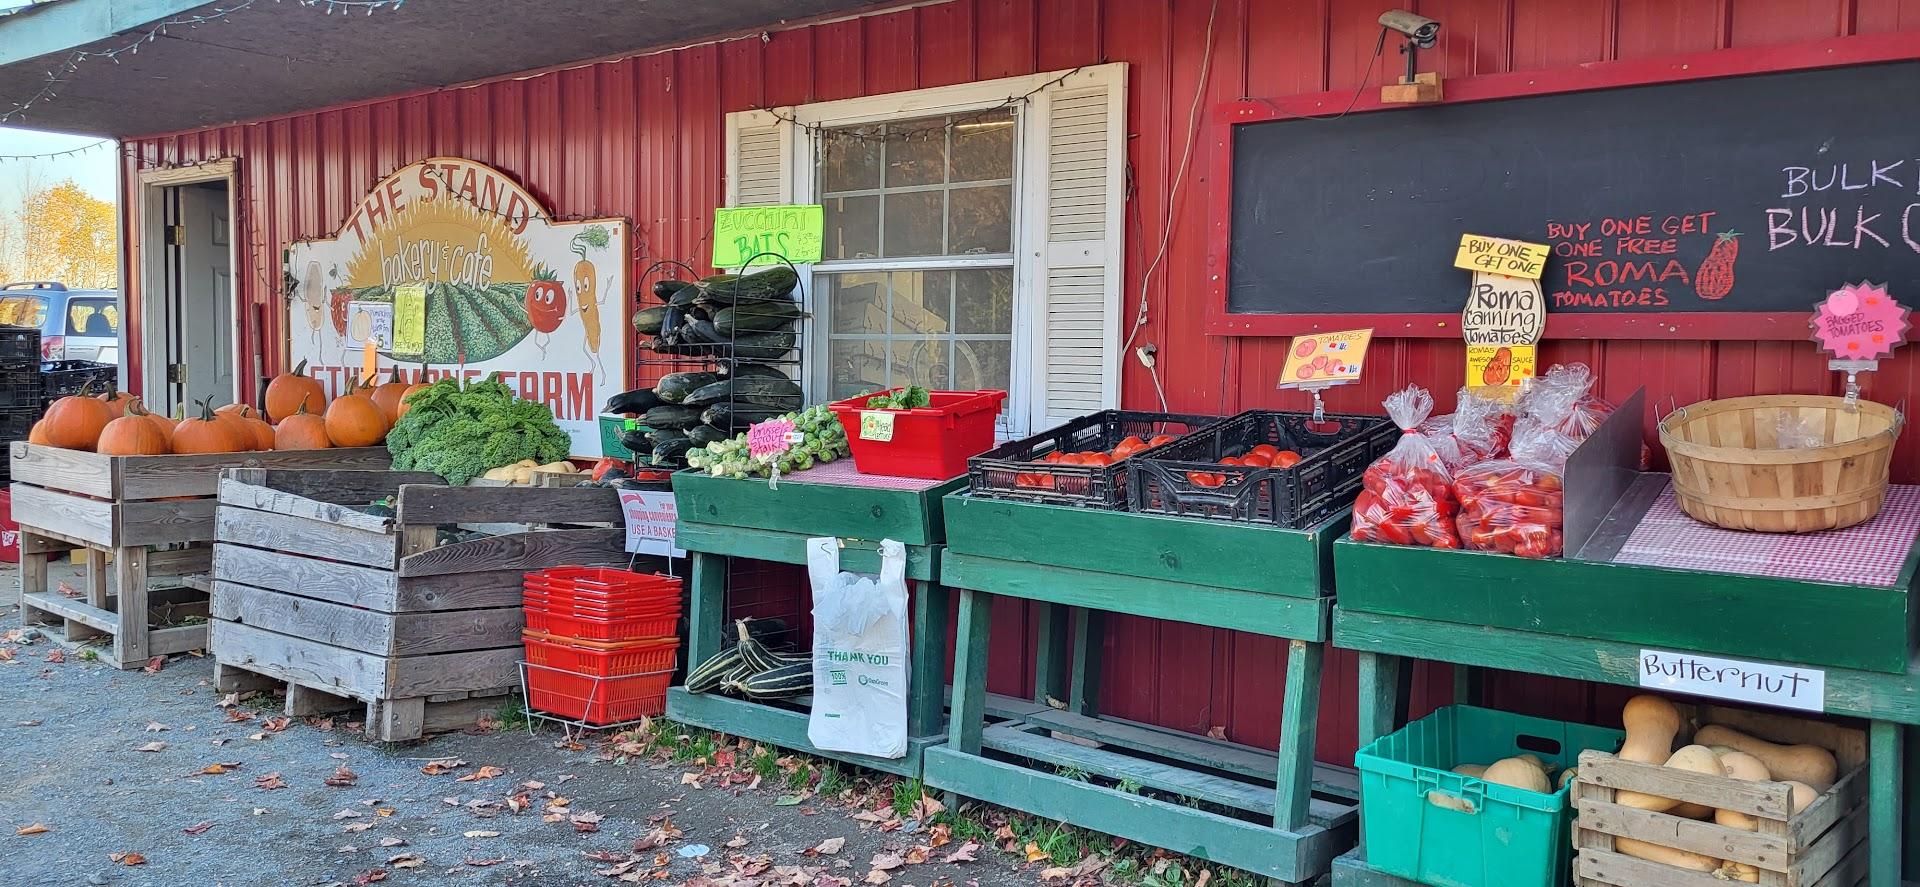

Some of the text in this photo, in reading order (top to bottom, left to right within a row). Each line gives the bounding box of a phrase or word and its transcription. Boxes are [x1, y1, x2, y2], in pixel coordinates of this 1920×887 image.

[1781, 160, 1904, 198] BULK
[347, 164, 529, 246] THE STAND
[1547, 211, 1716, 240] BUY ONE GET
[1765, 204, 1890, 251] BULK
[734, 232, 790, 264] BATS
[1469, 240, 1532, 261] BUY ONE
[1555, 236, 1677, 257] ONE FREE
[380, 236, 438, 294] bakery
[1474, 254, 1541, 274] GET ONE
[1563, 259, 1690, 287] ROMA
[1475, 284, 1535, 311] Roma
[1552, 288, 1670, 308] TOMATOES
[1318, 333, 1363, 344] TOMATOES
[1827, 320, 1884, 338] TOMATOES
[1469, 347, 1495, 355] ROMAS
[1473, 364, 1520, 372] TOMATO
[631, 524, 676, 538] USE A BASKE
[827, 651, 889, 666] THANK YOU
[1643, 654, 1809, 697] Butternut
